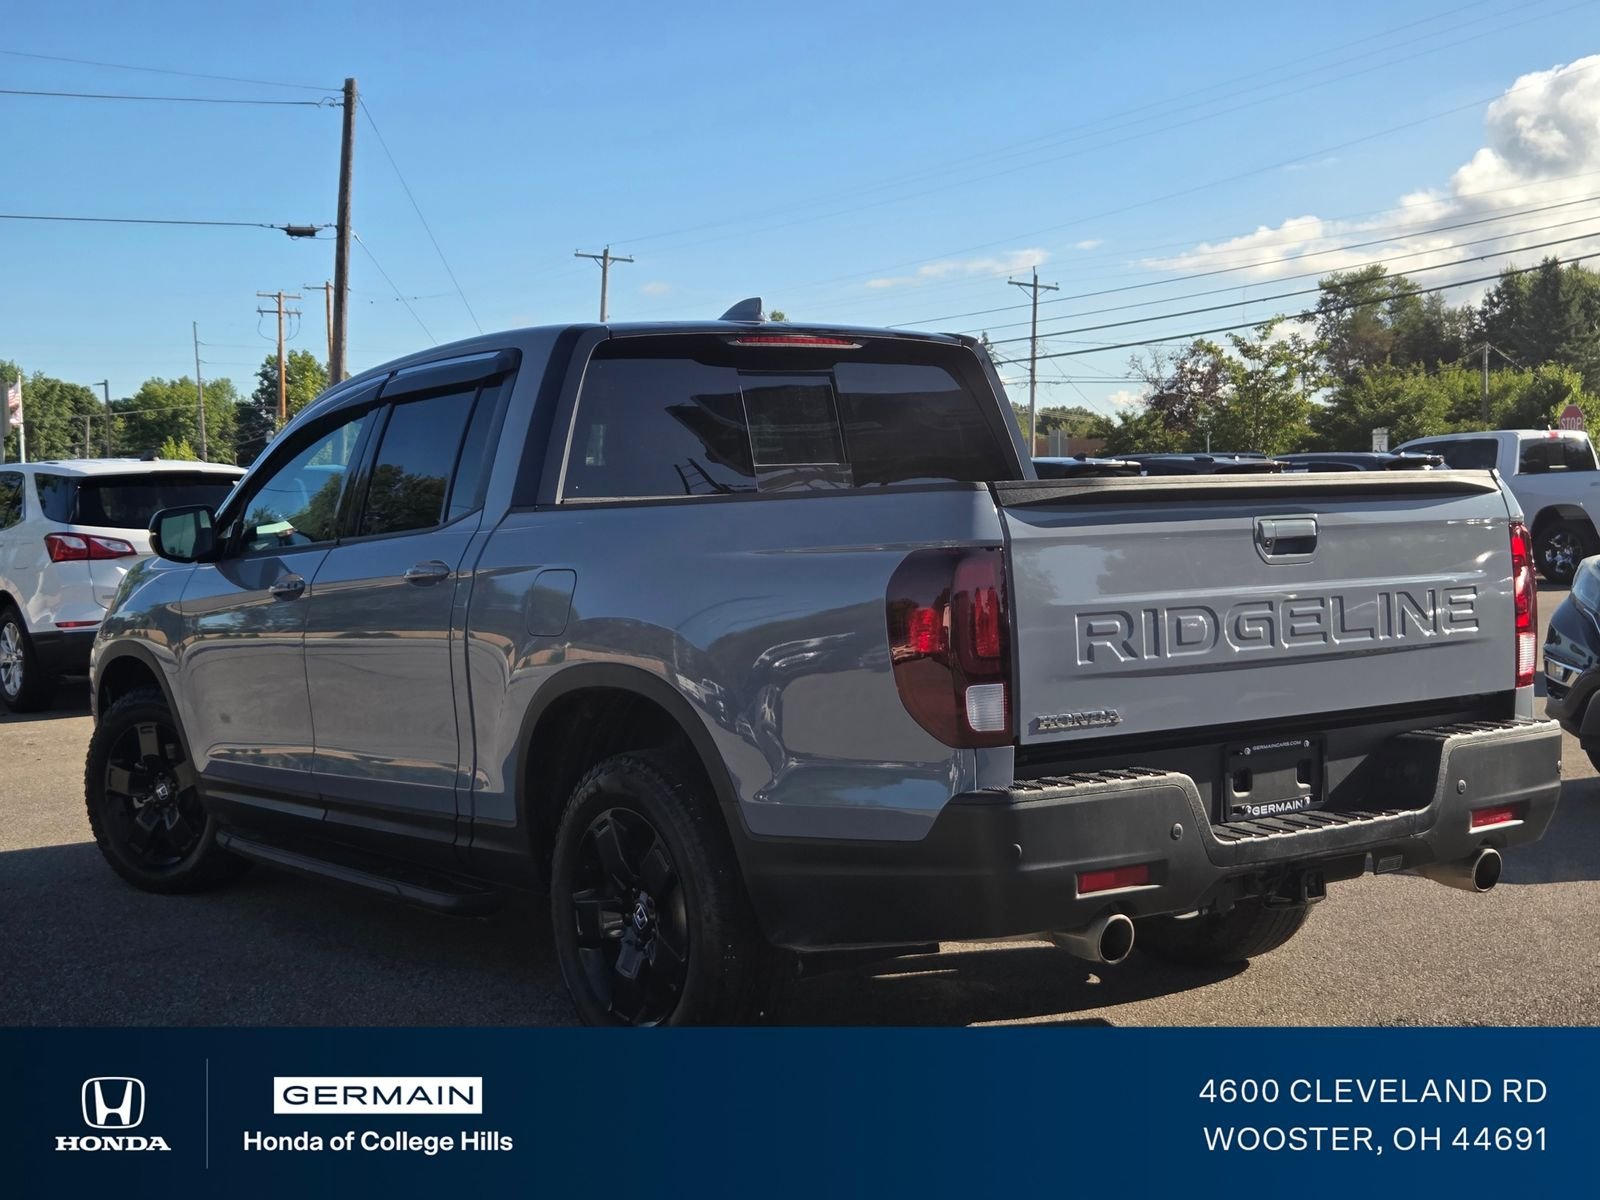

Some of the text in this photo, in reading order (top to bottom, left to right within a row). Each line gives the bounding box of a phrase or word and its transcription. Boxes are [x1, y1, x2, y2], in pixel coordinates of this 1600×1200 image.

[1560, 417, 1582, 430] STOP
[1075, 585, 1479, 666] RIDGELINE
[1036, 709, 1121, 730] HONDA
[1252, 740, 1302, 751] GERMAINCARS.COM
[1251, 799, 1303, 816] GERMAIN
